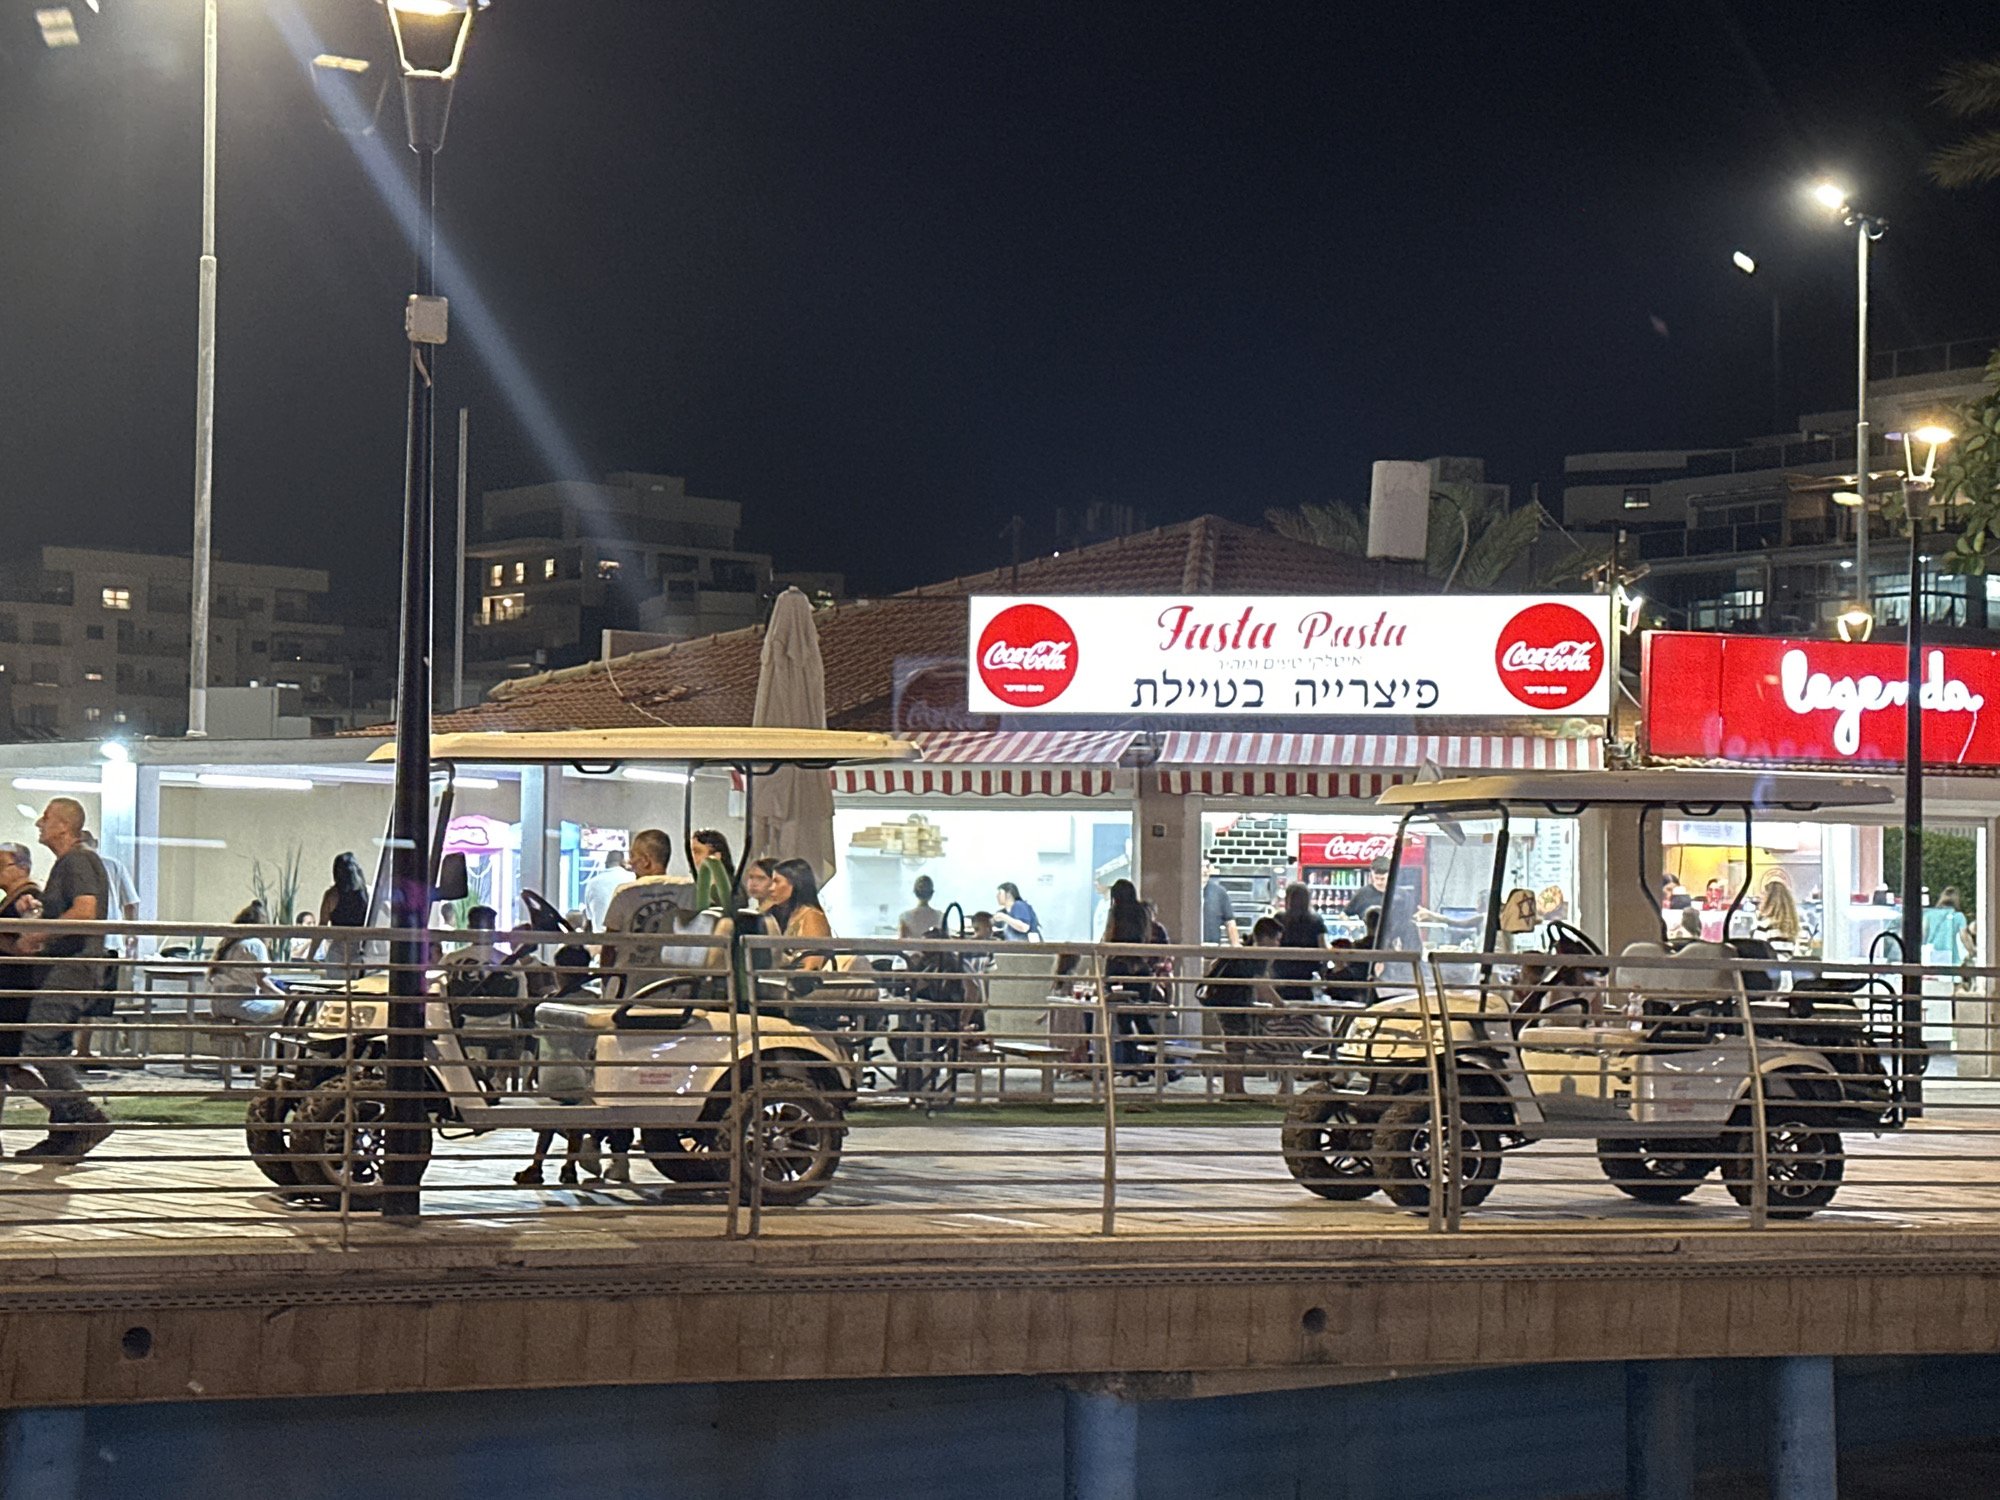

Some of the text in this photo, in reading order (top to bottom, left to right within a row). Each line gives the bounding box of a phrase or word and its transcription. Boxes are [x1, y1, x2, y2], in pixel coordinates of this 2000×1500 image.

[1298, 610, 1407, 650] Pasta
[983, 640, 1071, 670] Coca-Cola
[1501, 641, 1597, 671] Coca-Cola
[1129, 669, 1440, 710] פיצרייה בטיילת
